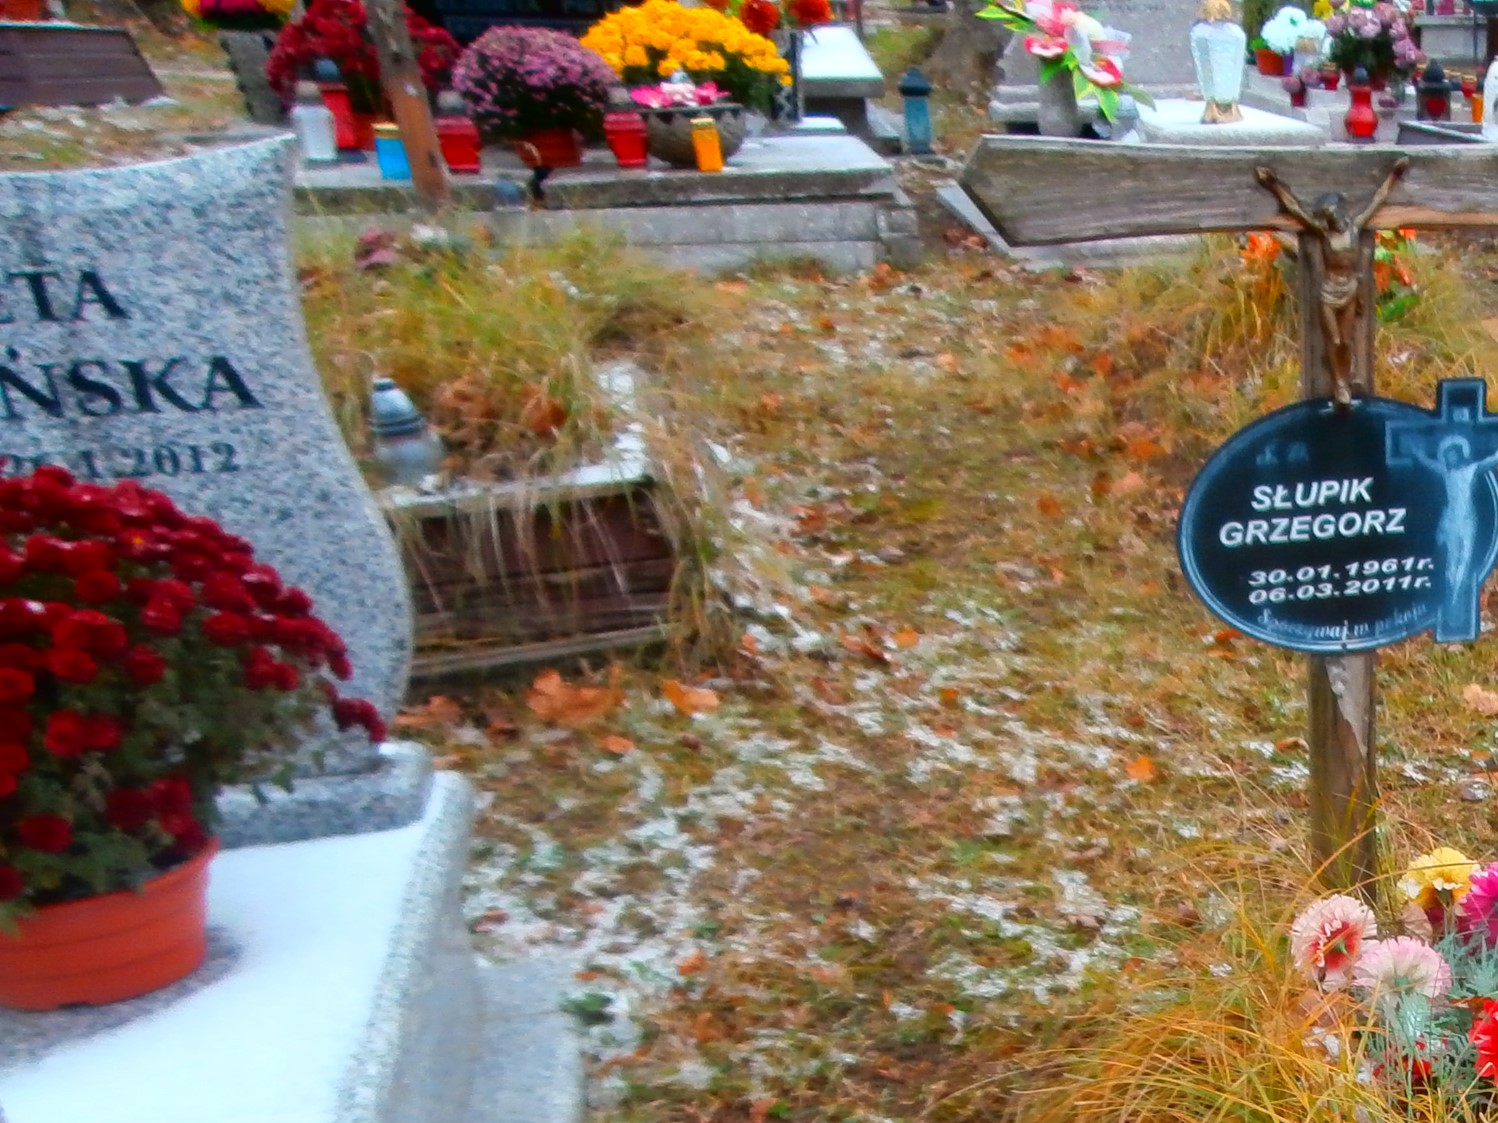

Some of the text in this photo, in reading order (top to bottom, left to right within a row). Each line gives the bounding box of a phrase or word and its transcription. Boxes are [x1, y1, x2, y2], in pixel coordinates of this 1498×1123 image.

[0, 270, 132, 323] TA
[1250, 476, 1374, 511] SŁUPIK
[1219, 507, 1408, 547] GRZEGORZ
[1248, 556, 1435, 587] 30.01.1961r.
[1248, 574, 1433, 605] 06.03.2011r.
